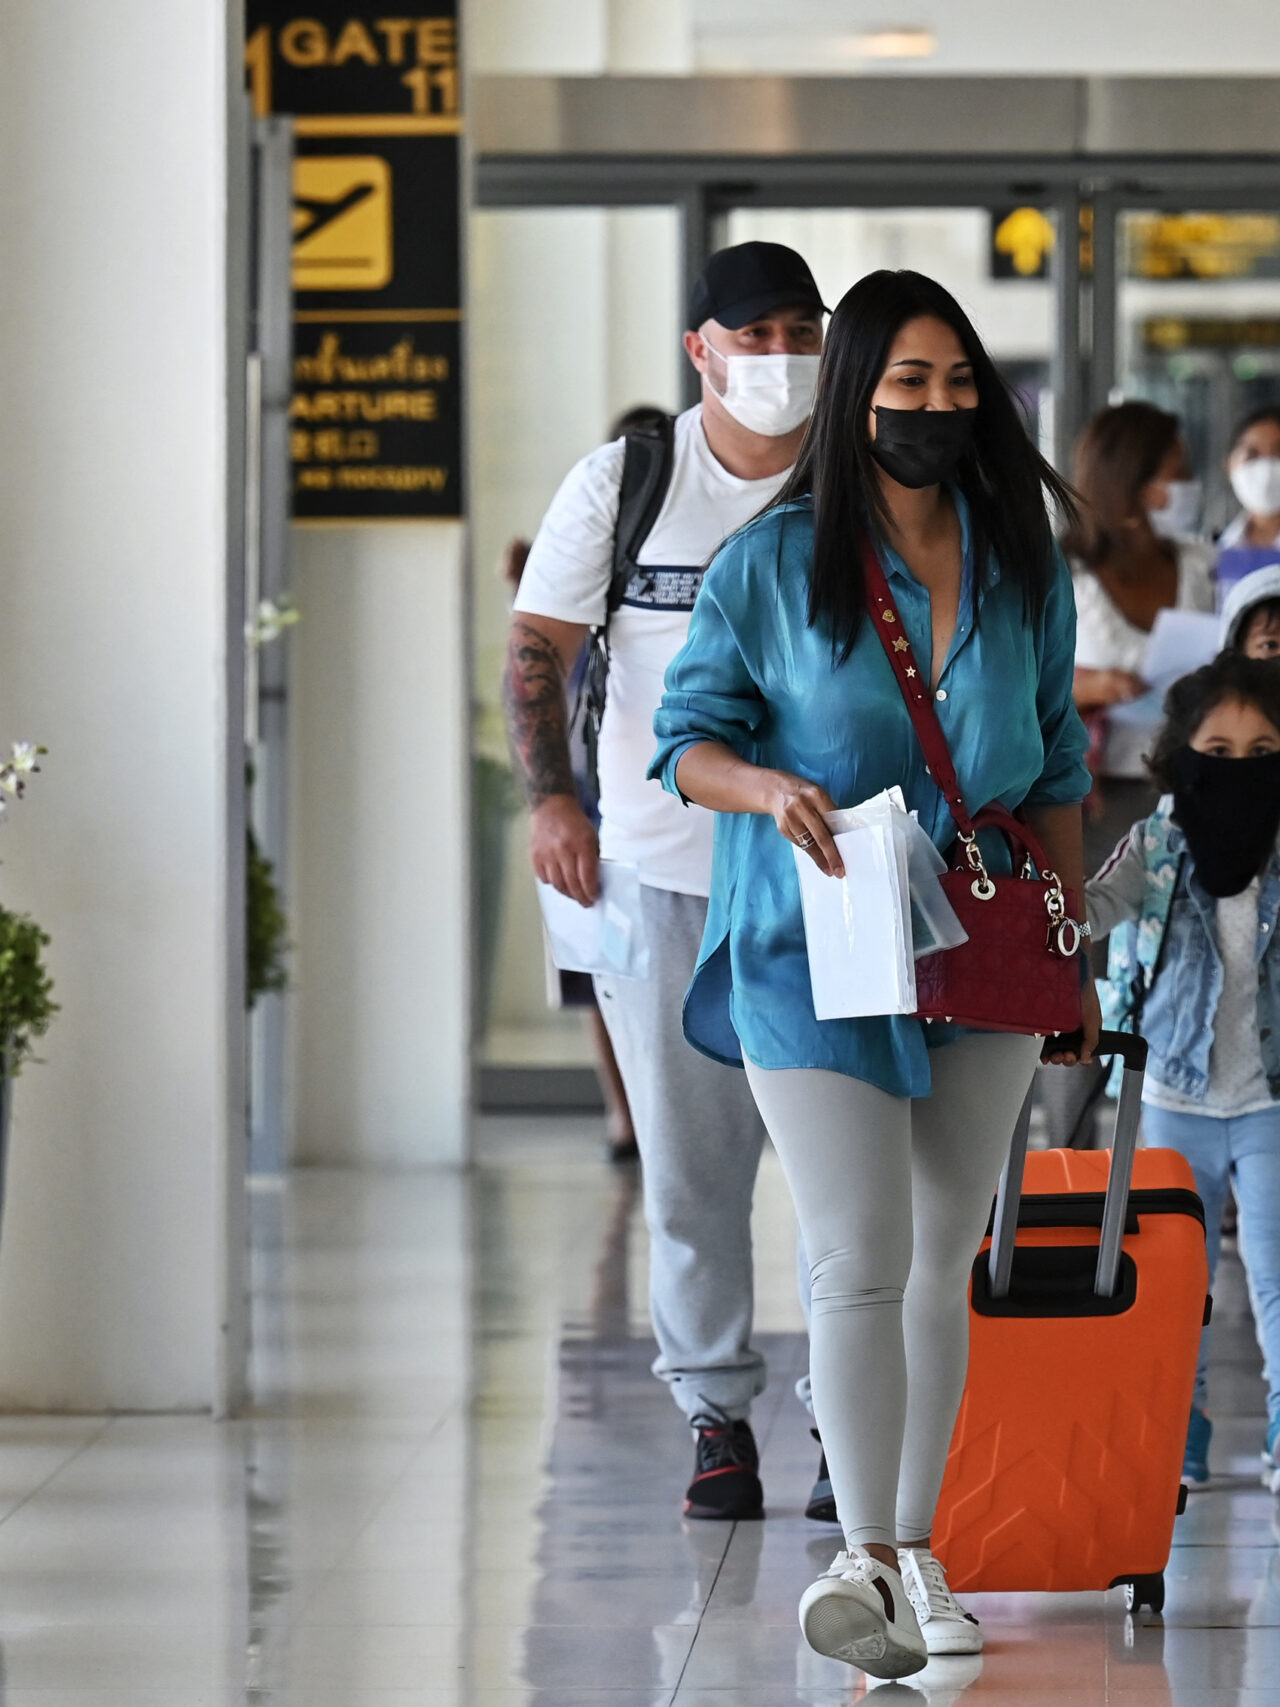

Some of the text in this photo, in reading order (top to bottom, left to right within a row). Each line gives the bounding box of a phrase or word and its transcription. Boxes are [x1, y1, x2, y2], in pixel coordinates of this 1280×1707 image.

[280, 18, 456, 66] GATE
[402, 67, 457, 115] 11
[288, 390, 437, 421] ARTURE
